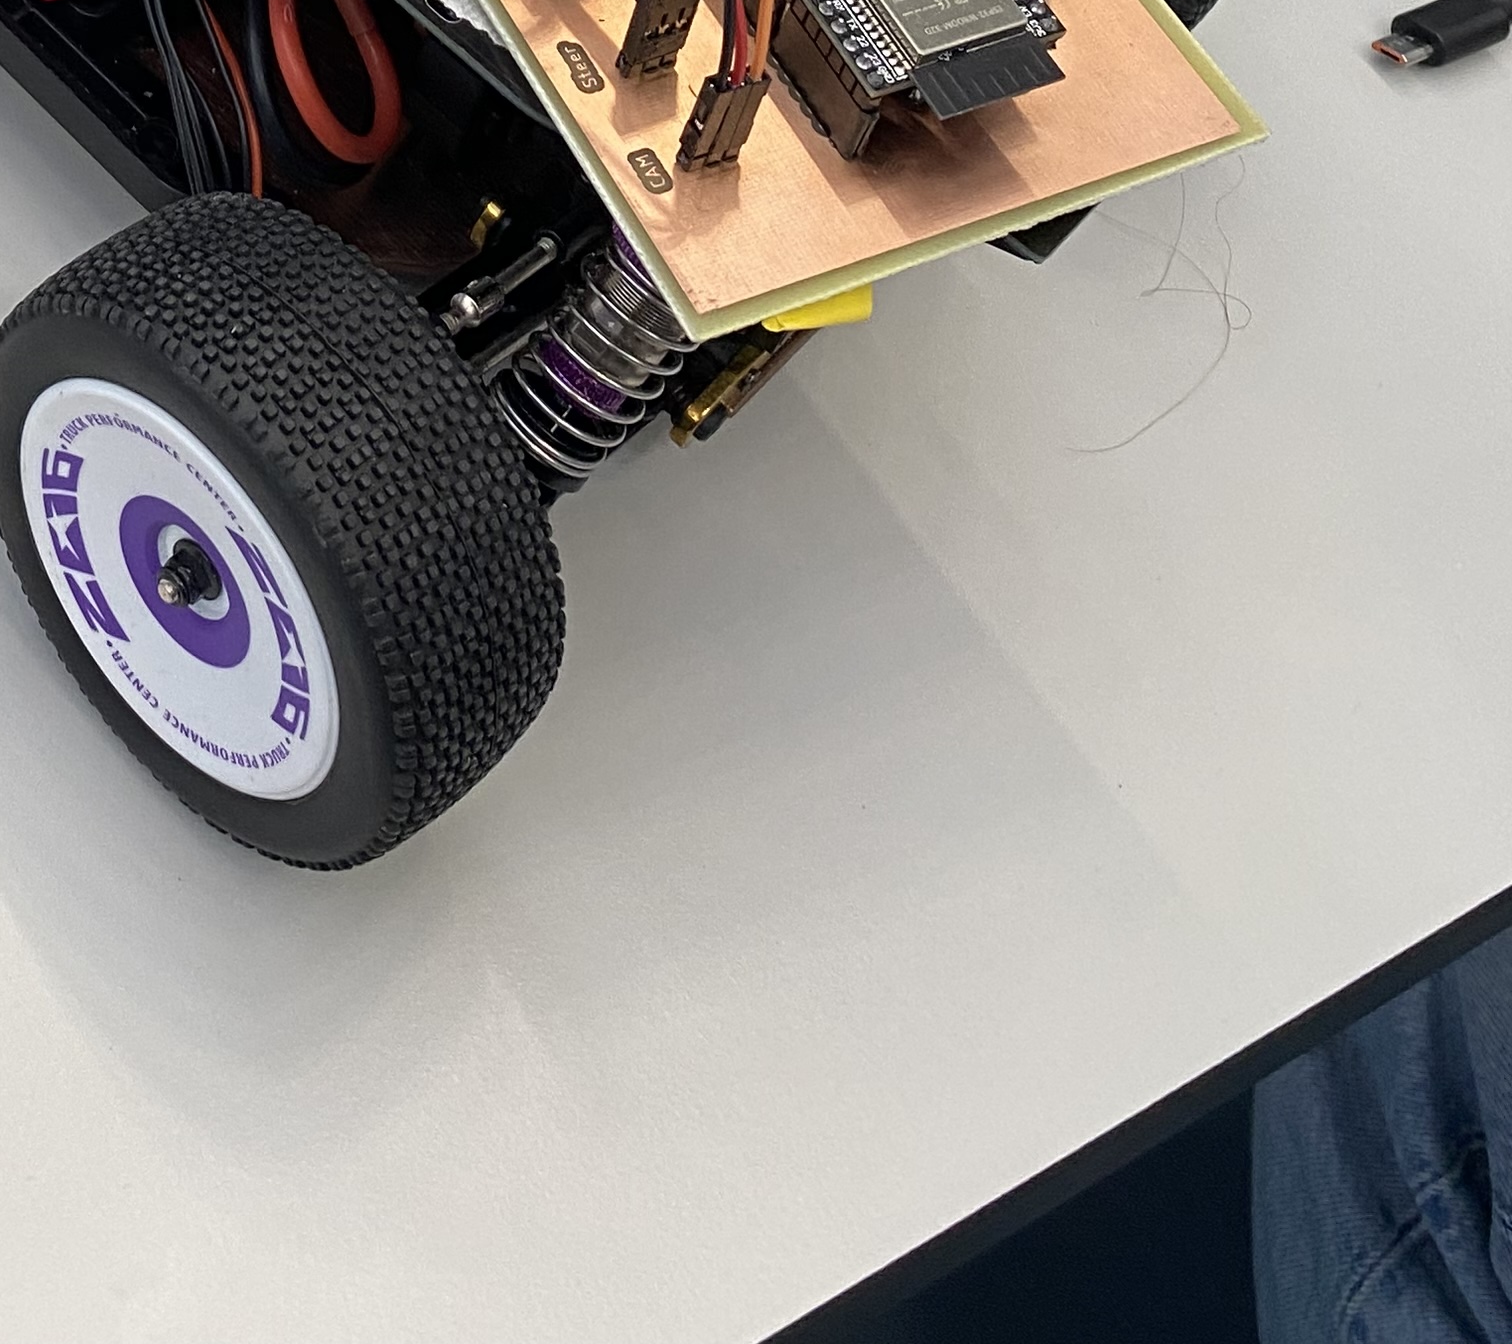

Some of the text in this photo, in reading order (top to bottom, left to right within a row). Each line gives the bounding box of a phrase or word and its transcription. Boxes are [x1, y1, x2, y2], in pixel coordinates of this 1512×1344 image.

[846, 19, 858, 31] TX
[856, 35, 869, 48] 22
[564, 46, 598, 89] Steer
[878, 65, 895, 83] GND
[635, 153, 666, 189] CAM
[59, 413, 237, 522] TRUCK PERFORMANCE CENTER
[111, 650, 290, 769] TRUCK PERFORMANCE CENTER
